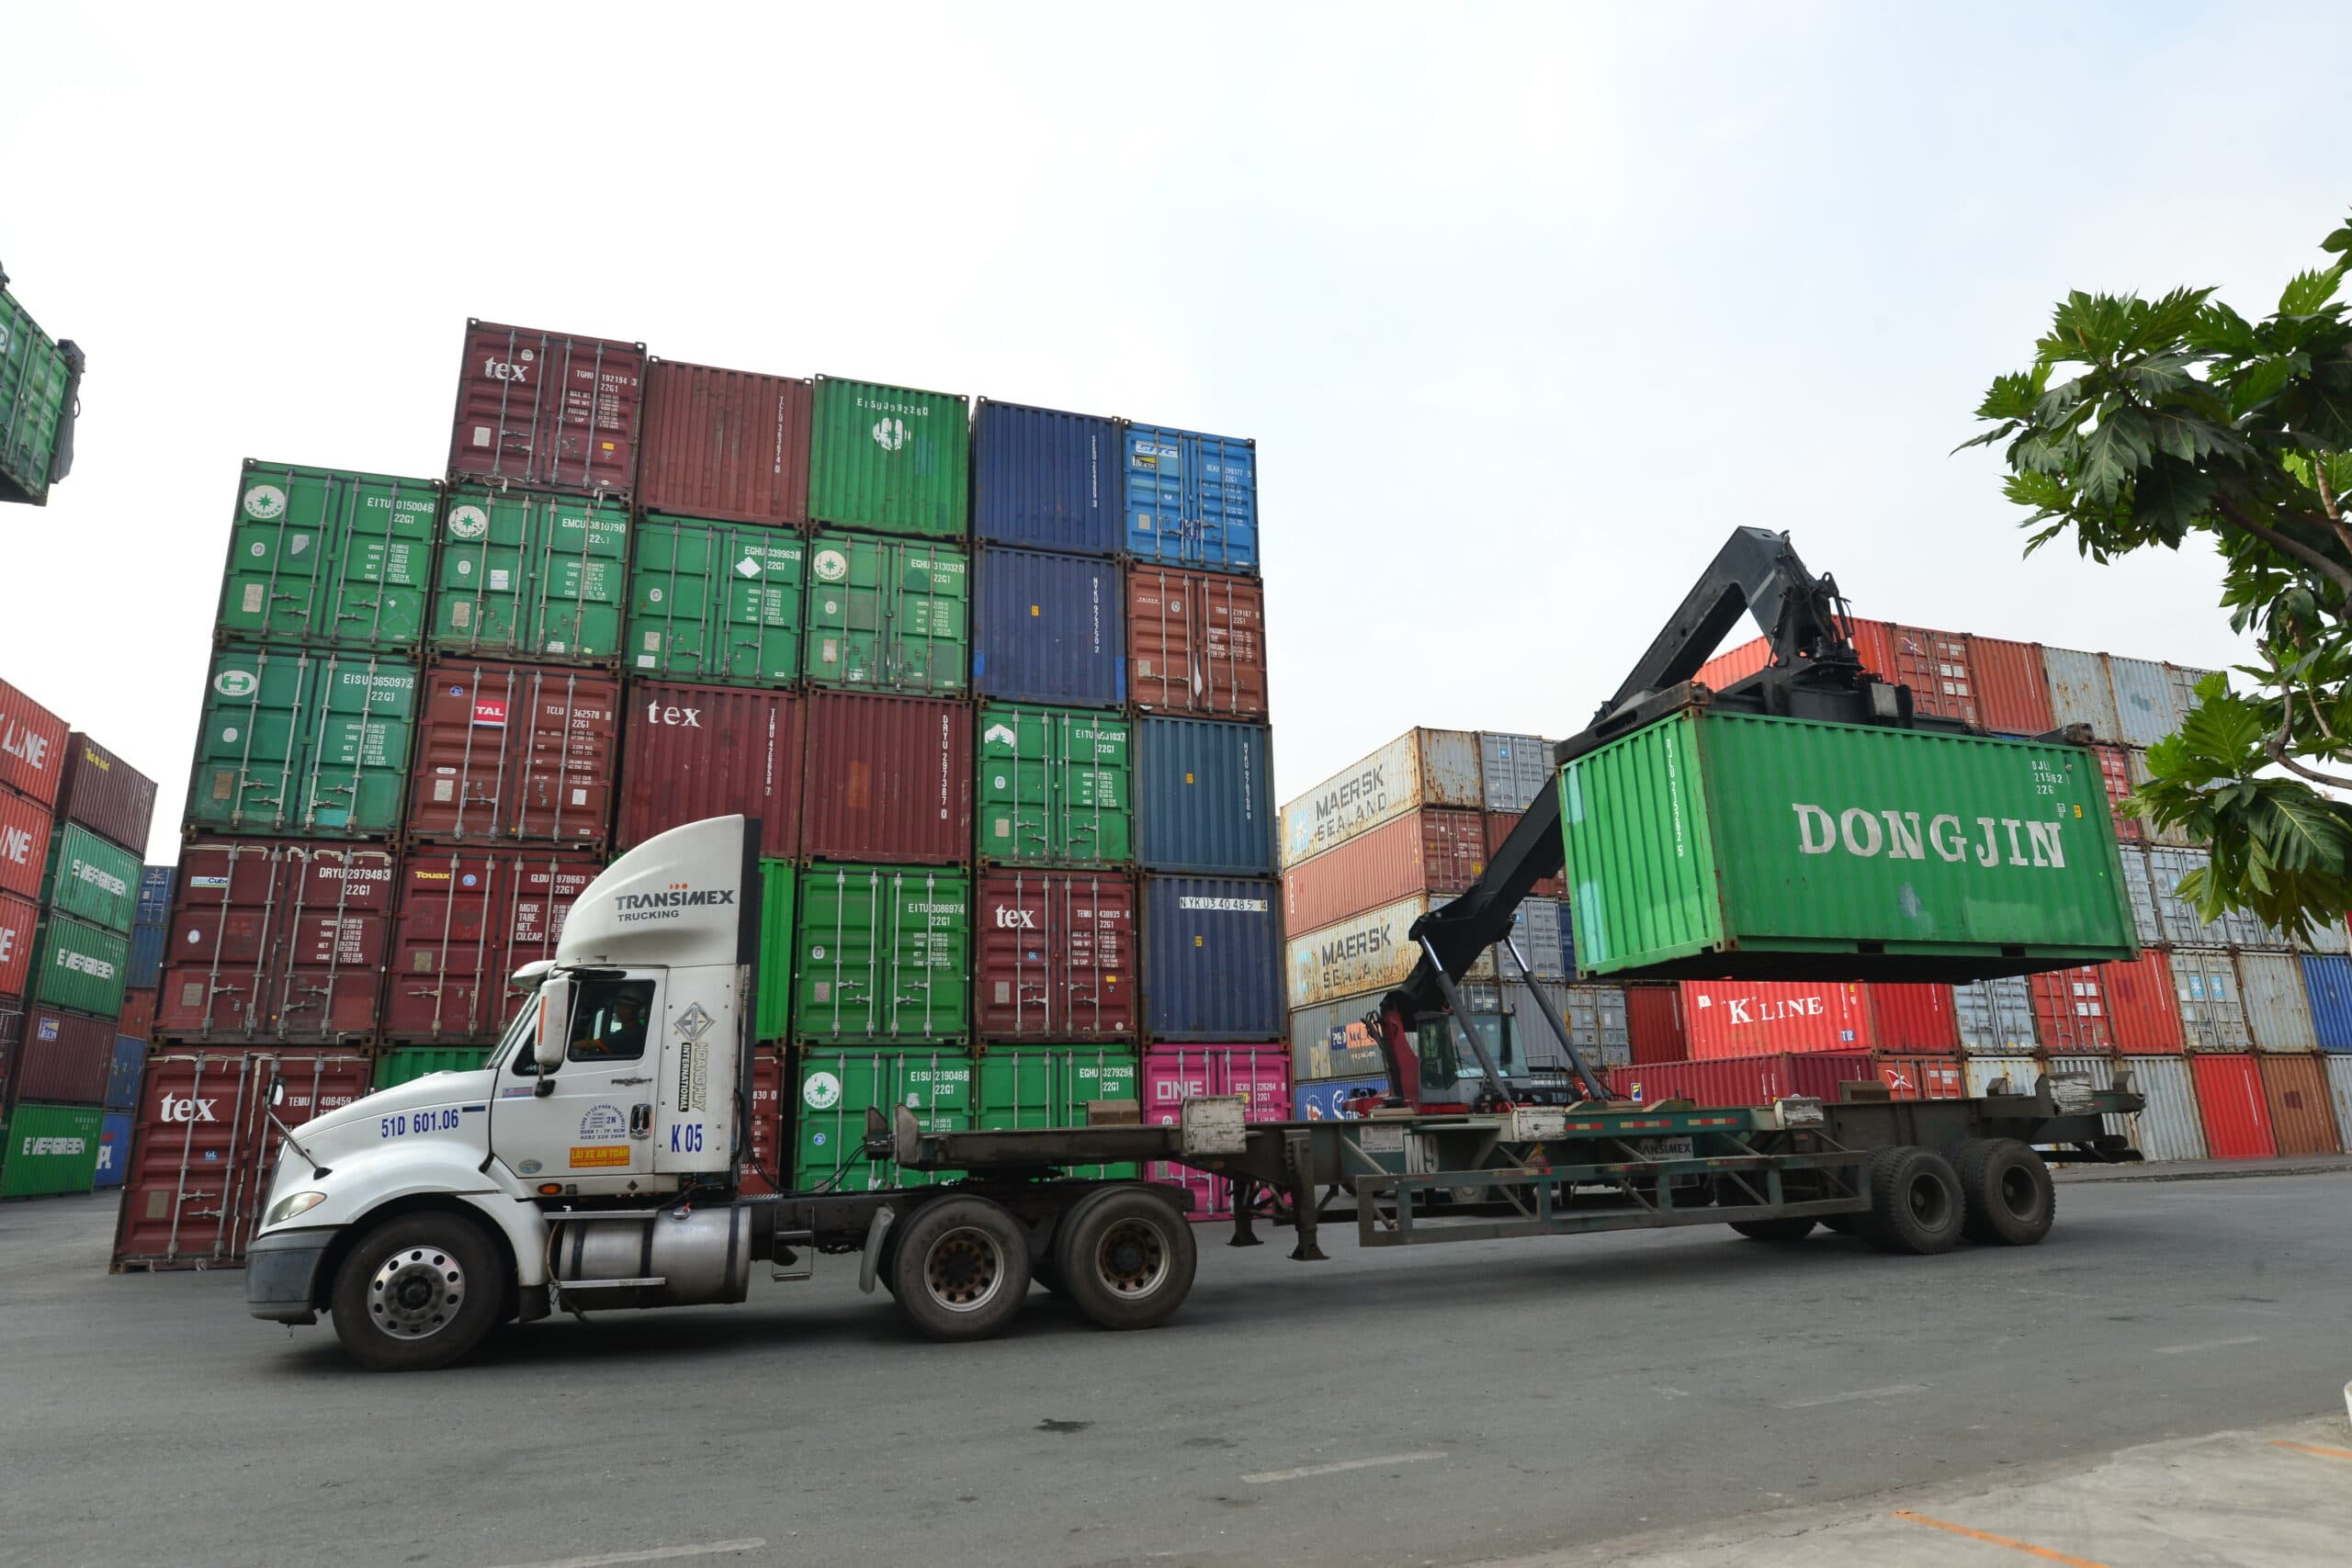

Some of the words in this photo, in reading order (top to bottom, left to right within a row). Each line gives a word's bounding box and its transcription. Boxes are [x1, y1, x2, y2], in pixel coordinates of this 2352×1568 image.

[484, 355, 529, 383] tex
[576, 369, 594, 379] TGHU
[602, 374, 628, 385] 192194
[368, 497, 391, 508] EITU
[393, 513, 415, 525] 22G1
[562, 517, 584, 529] EMCU
[744, 546, 765, 557] EGHU
[766, 560, 785, 570] 22G1
[910, 558, 931, 569] EGHU
[933, 573, 951, 584] 22G1
[344, 673, 368, 686] EISU
[370, 692, 395, 702] 22G1
[475, 706, 503, 716] TAL
[546, 705, 564, 716] TCLU
[573, 708, 600, 720] 362578
[647, 699, 703, 728] tex
[571, 719, 590, 729] 22G1
[1075, 729, 1093, 739] EITU
[1097, 744, 1115, 754] 22G1
[941, 752, 949, 806] 297387
[1316, 763, 1385, 821] MAERSK
[1792, 802, 2066, 869] DONGJIN
[319, 866, 345, 880] DRYU
[346, 867, 392, 882] 2979483
[530, 874, 549, 884] GLDU
[557, 874, 585, 885] 970663
[345, 884, 371, 896] 22G1
[554, 885, 574, 895] 22G1
[615, 889, 735, 911] TRANSIMEX
[518, 903, 540, 913] MGW.
[908, 903, 928, 914] EITU
[518, 912, 538, 922] TARE.
[617, 909, 680, 923] TRUCKING
[995, 903, 1035, 929] tex
[1099, 909, 1121, 919] 430935
[516, 922, 533, 932] NET.
[931, 916, 951, 927] 22G1
[1099, 919, 1114, 930] 22G1
[515, 931, 543, 942] CU.CAP.
[1321, 923, 1392, 968] MAERSK
[57, 948, 115, 980] EVERGREEN
[1760, 996, 1824, 1021] LINE
[680, 1044, 691, 1111] INTERNATIONAL
[910, 1070, 932, 1082] EISU
[1079, 1067, 1099, 1078] EGHU
[934, 1084, 954, 1095] 22G1
[1102, 1081, 1119, 1092] 22G1
[1157, 1080, 1203, 1101] ONE
[160, 1090, 219, 1122] tex
[288, 1096, 311, 1107] TEMU
[320, 1096, 352, 1107] 406459
[381, 1117, 406, 1138] 51D
[413, 1108, 458, 1134] 601.06
[605, 1116, 617, 1124] 2N
[671, 1123, 682, 1154] K
[685, 1123, 703, 1154] 05
[22, 1136, 87, 1156] EVERGREEN
